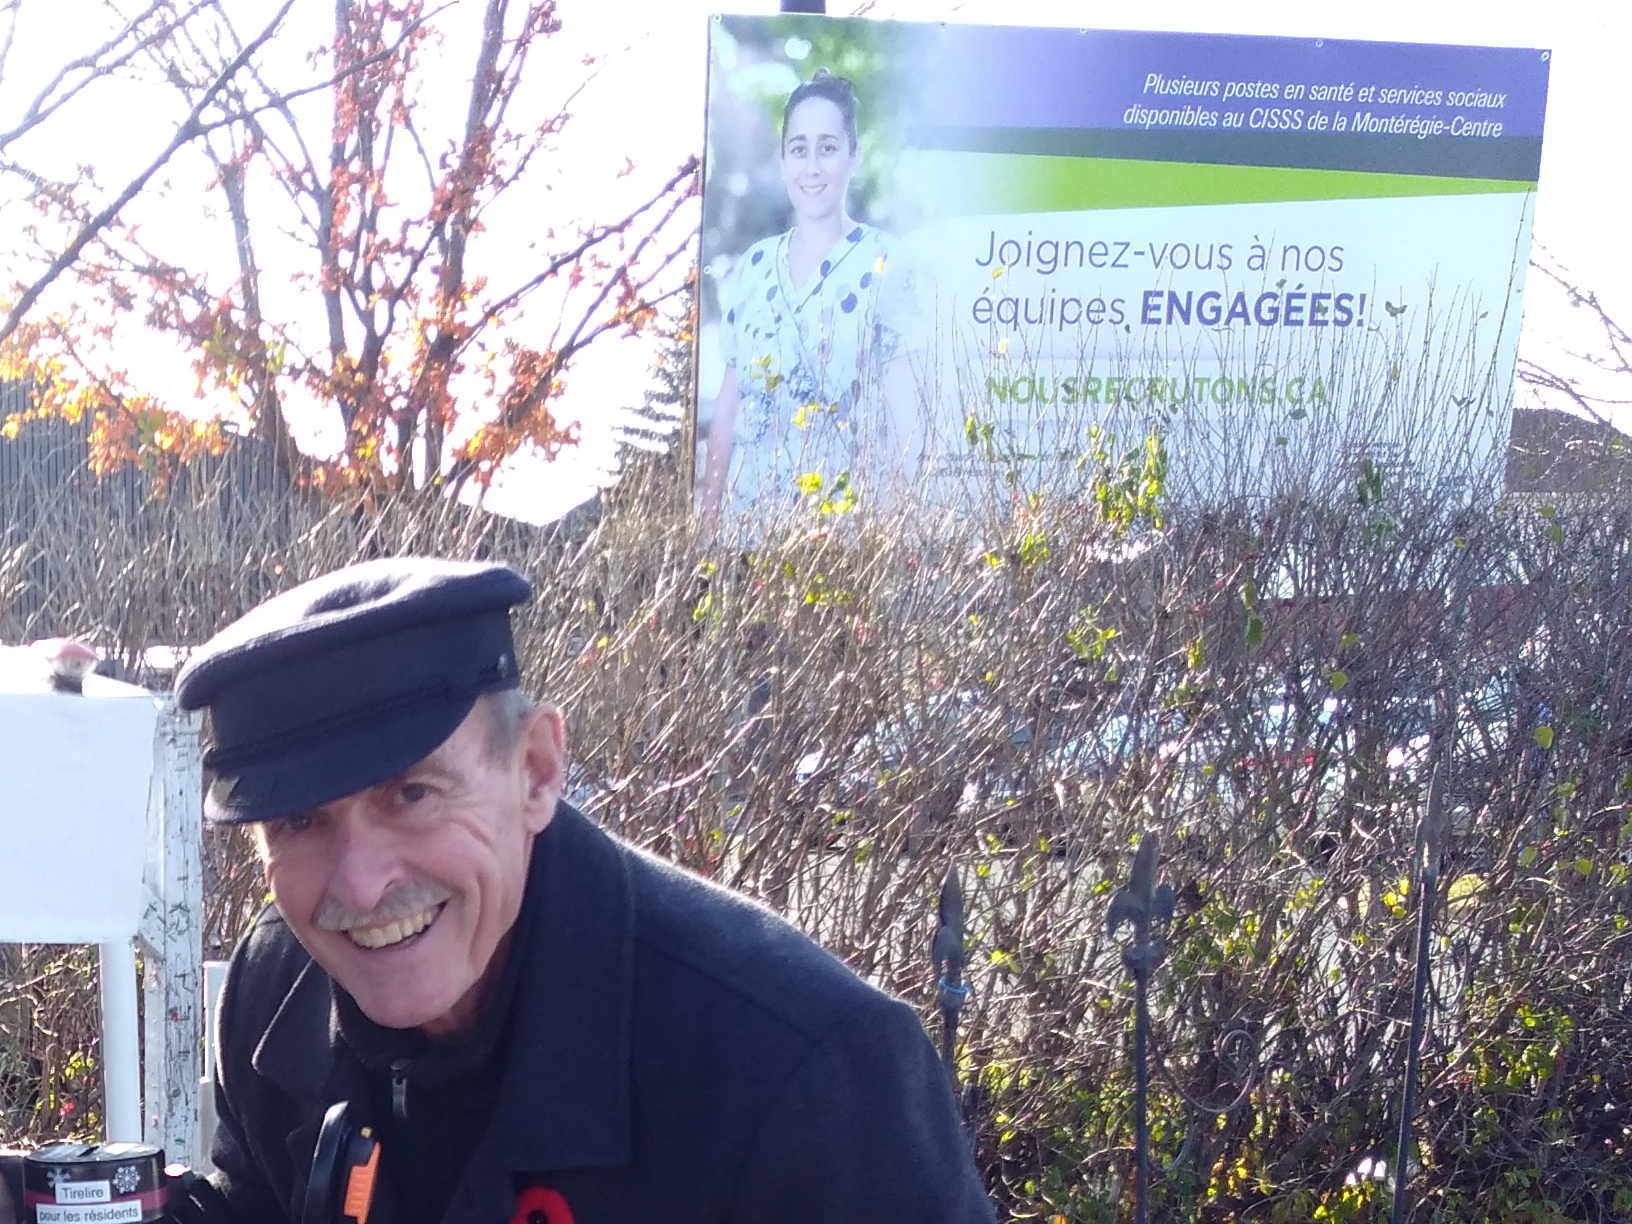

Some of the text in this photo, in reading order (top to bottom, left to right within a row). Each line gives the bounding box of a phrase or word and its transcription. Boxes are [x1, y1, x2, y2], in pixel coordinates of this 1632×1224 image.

[1143, 73, 1507, 109] Plusieurs postes en santé et services sociaux
[1123, 104, 1503, 139] disponibles au CISSS de la Montérégie-Centre
[975, 231, 1345, 275] Joignez-vous à nos
[972, 283, 1367, 331] équipes ENGAGÉES!
[986, 376, 1328, 404] NOUSRECRUTONS.CA
[61, 1187, 104, 1199] Tirelire
[39, 1207, 139, 1222] pour les résidents
